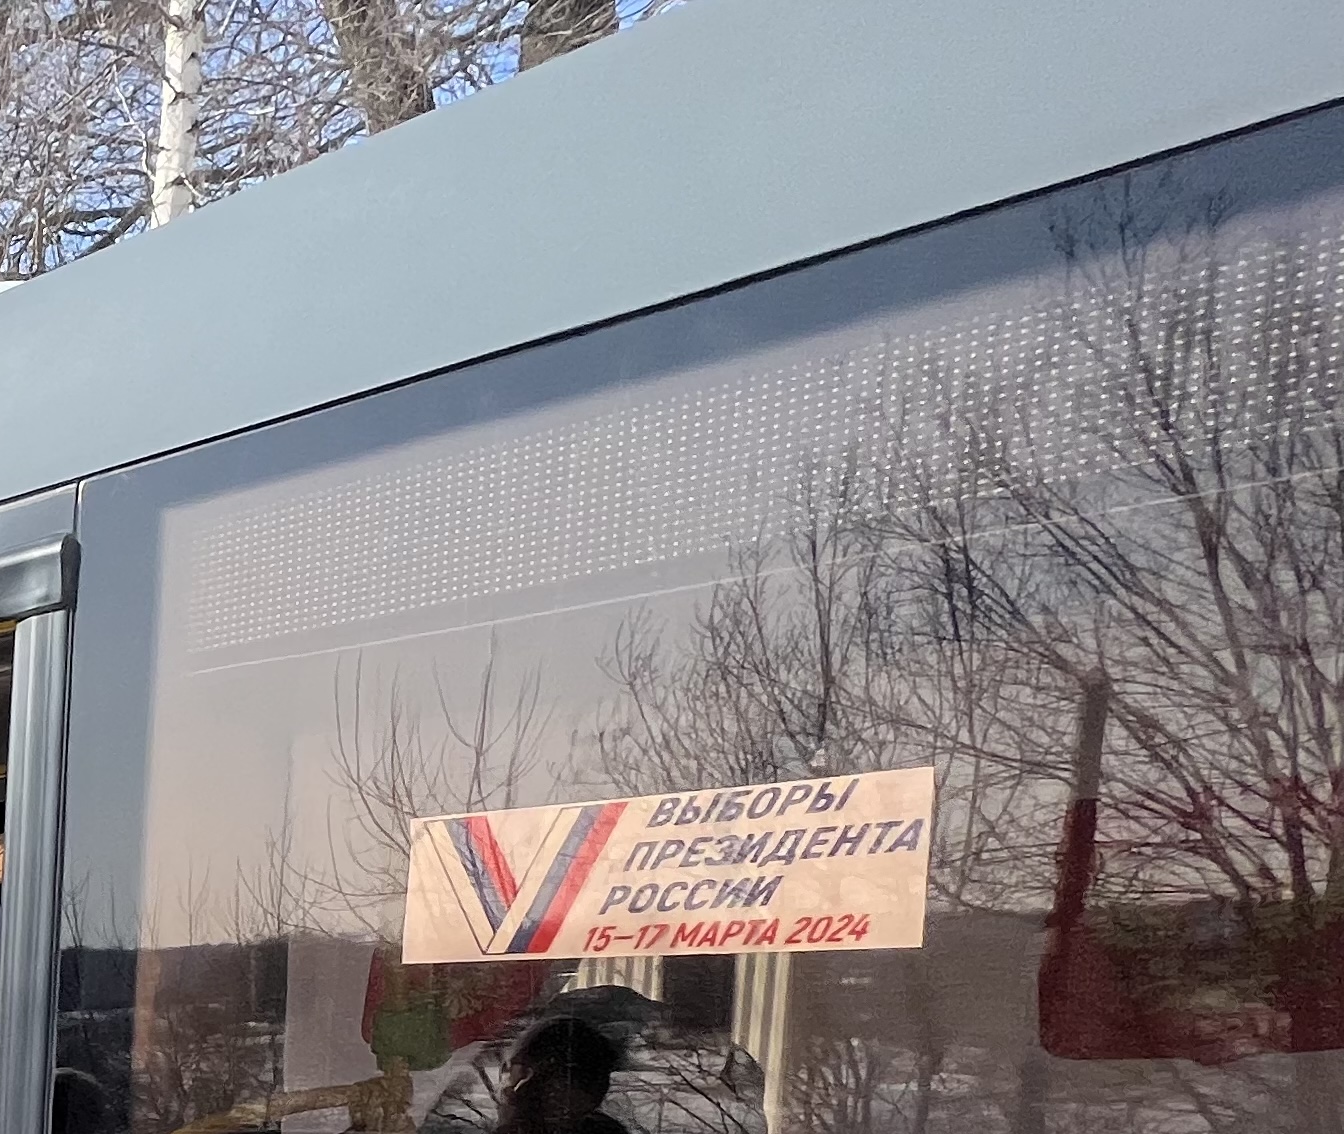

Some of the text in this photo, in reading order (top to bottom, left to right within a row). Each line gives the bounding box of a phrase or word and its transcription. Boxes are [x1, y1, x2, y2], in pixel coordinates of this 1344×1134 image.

[645, 778, 860, 829] ВЫБОРЫ
[623, 818, 925, 873] ПРЕЗИДЕНТА
[598, 875, 785, 916] РОССИИ
[671, 918, 780, 948] МАРТА
[783, 914, 871, 945] 2024
